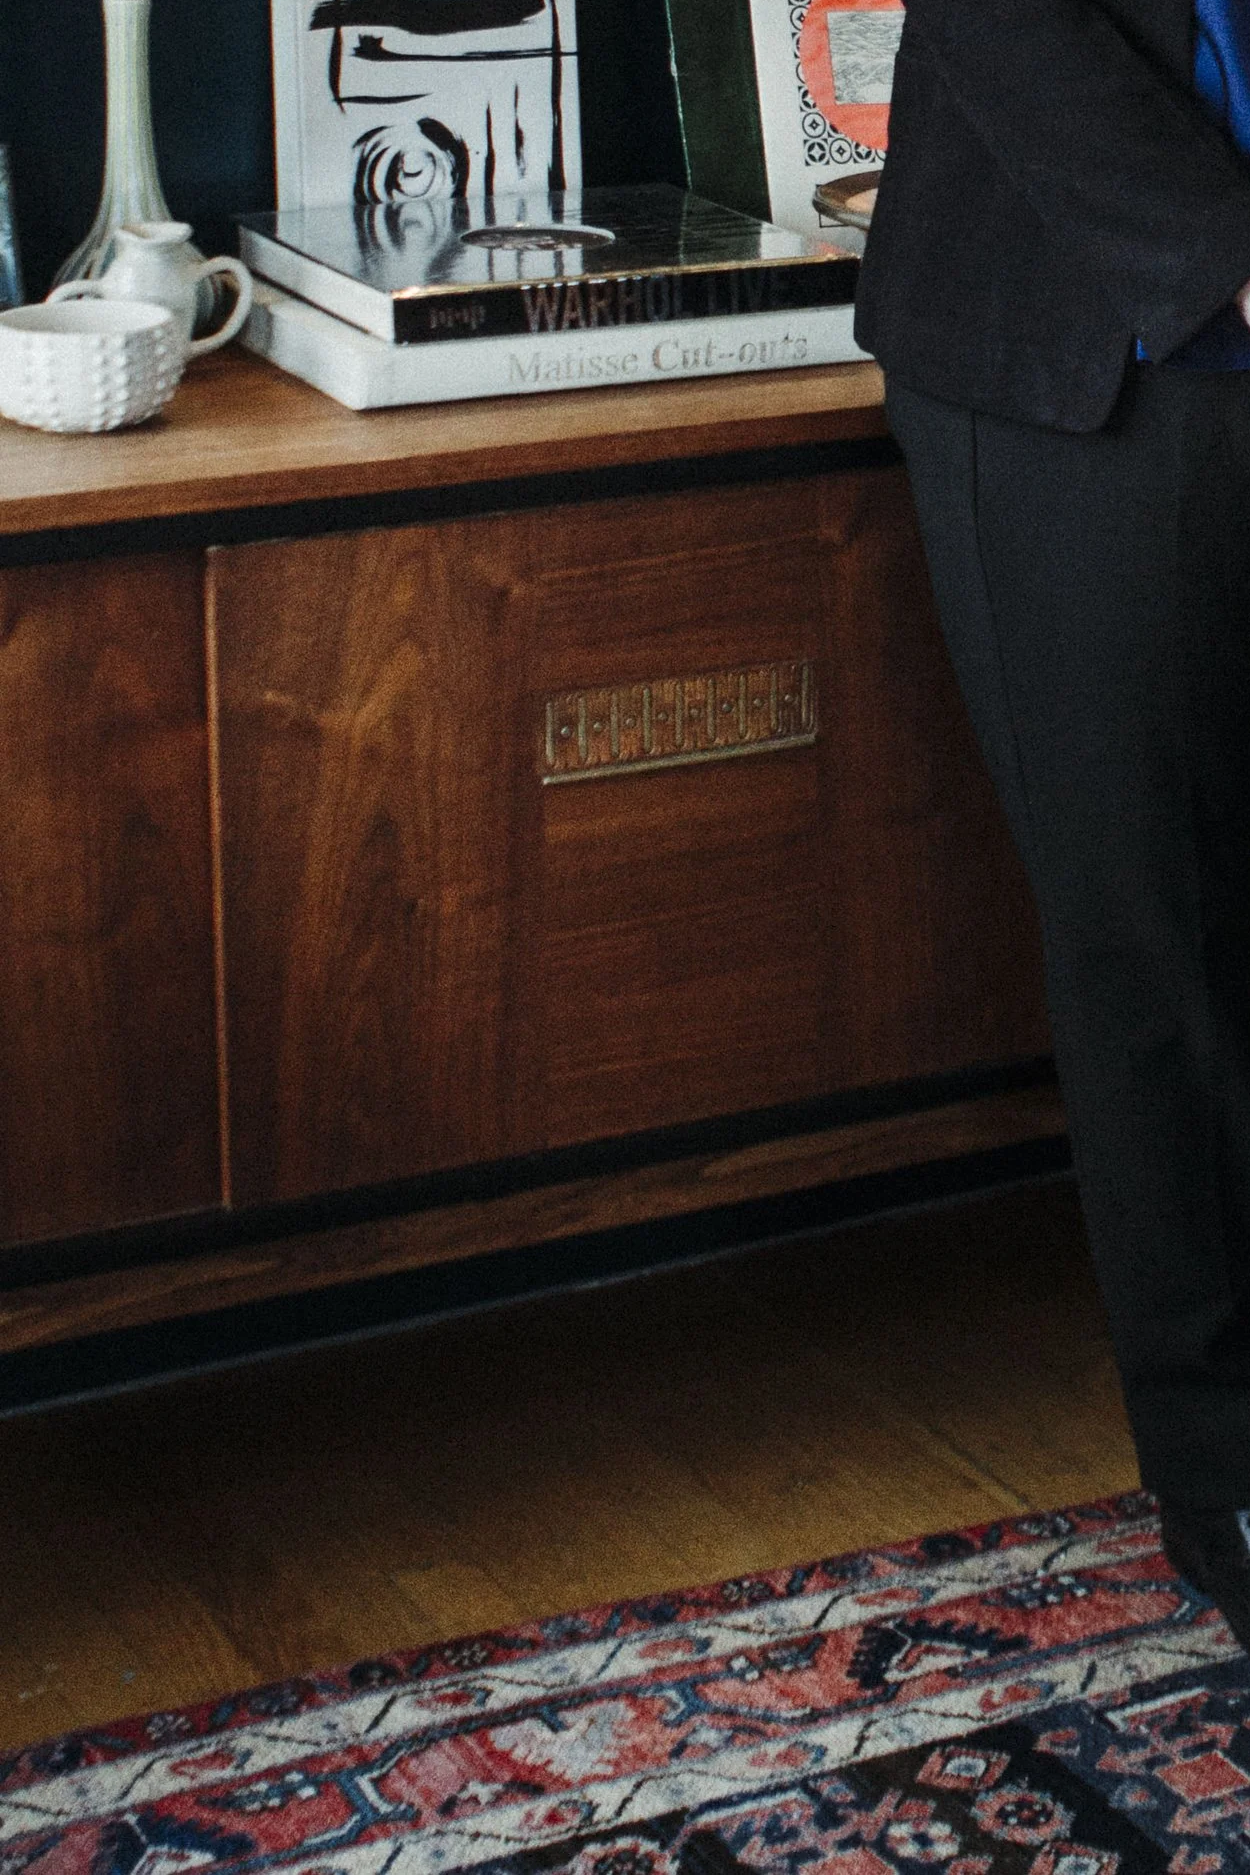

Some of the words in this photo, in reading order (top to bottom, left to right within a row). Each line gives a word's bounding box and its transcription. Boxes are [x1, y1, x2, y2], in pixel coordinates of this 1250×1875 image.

[519, 273, 695, 333] WARHOL
[703, 268, 790, 316] LIVE
[507, 346, 639, 385] Matisse
[651, 332, 809, 373] Cut-outs
